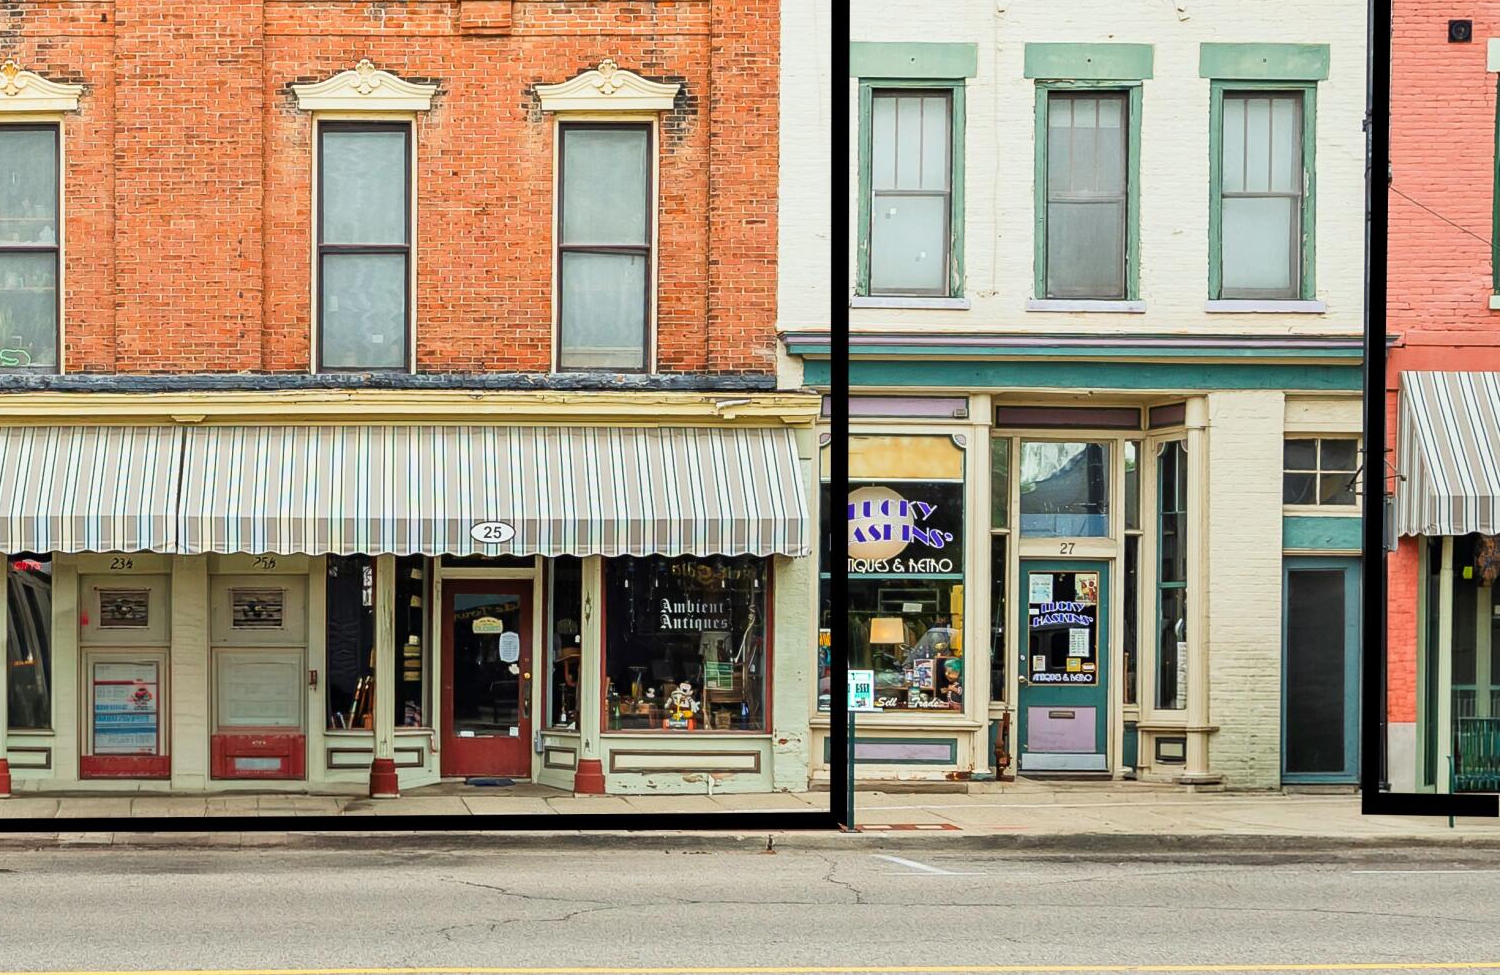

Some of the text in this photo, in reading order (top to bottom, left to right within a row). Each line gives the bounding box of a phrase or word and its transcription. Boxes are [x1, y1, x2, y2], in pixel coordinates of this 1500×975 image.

[483, 526, 503, 539] 25
[1059, 542, 1076, 555] 27
[892, 558, 905, 573] &
[908, 558, 953, 573] RETRO
[660, 598, 724, 614] Ambient
[1041, 600, 1085, 614] LUCKY
[660, 613, 729, 632] Antiques
[877, 697, 898, 707] Sell
